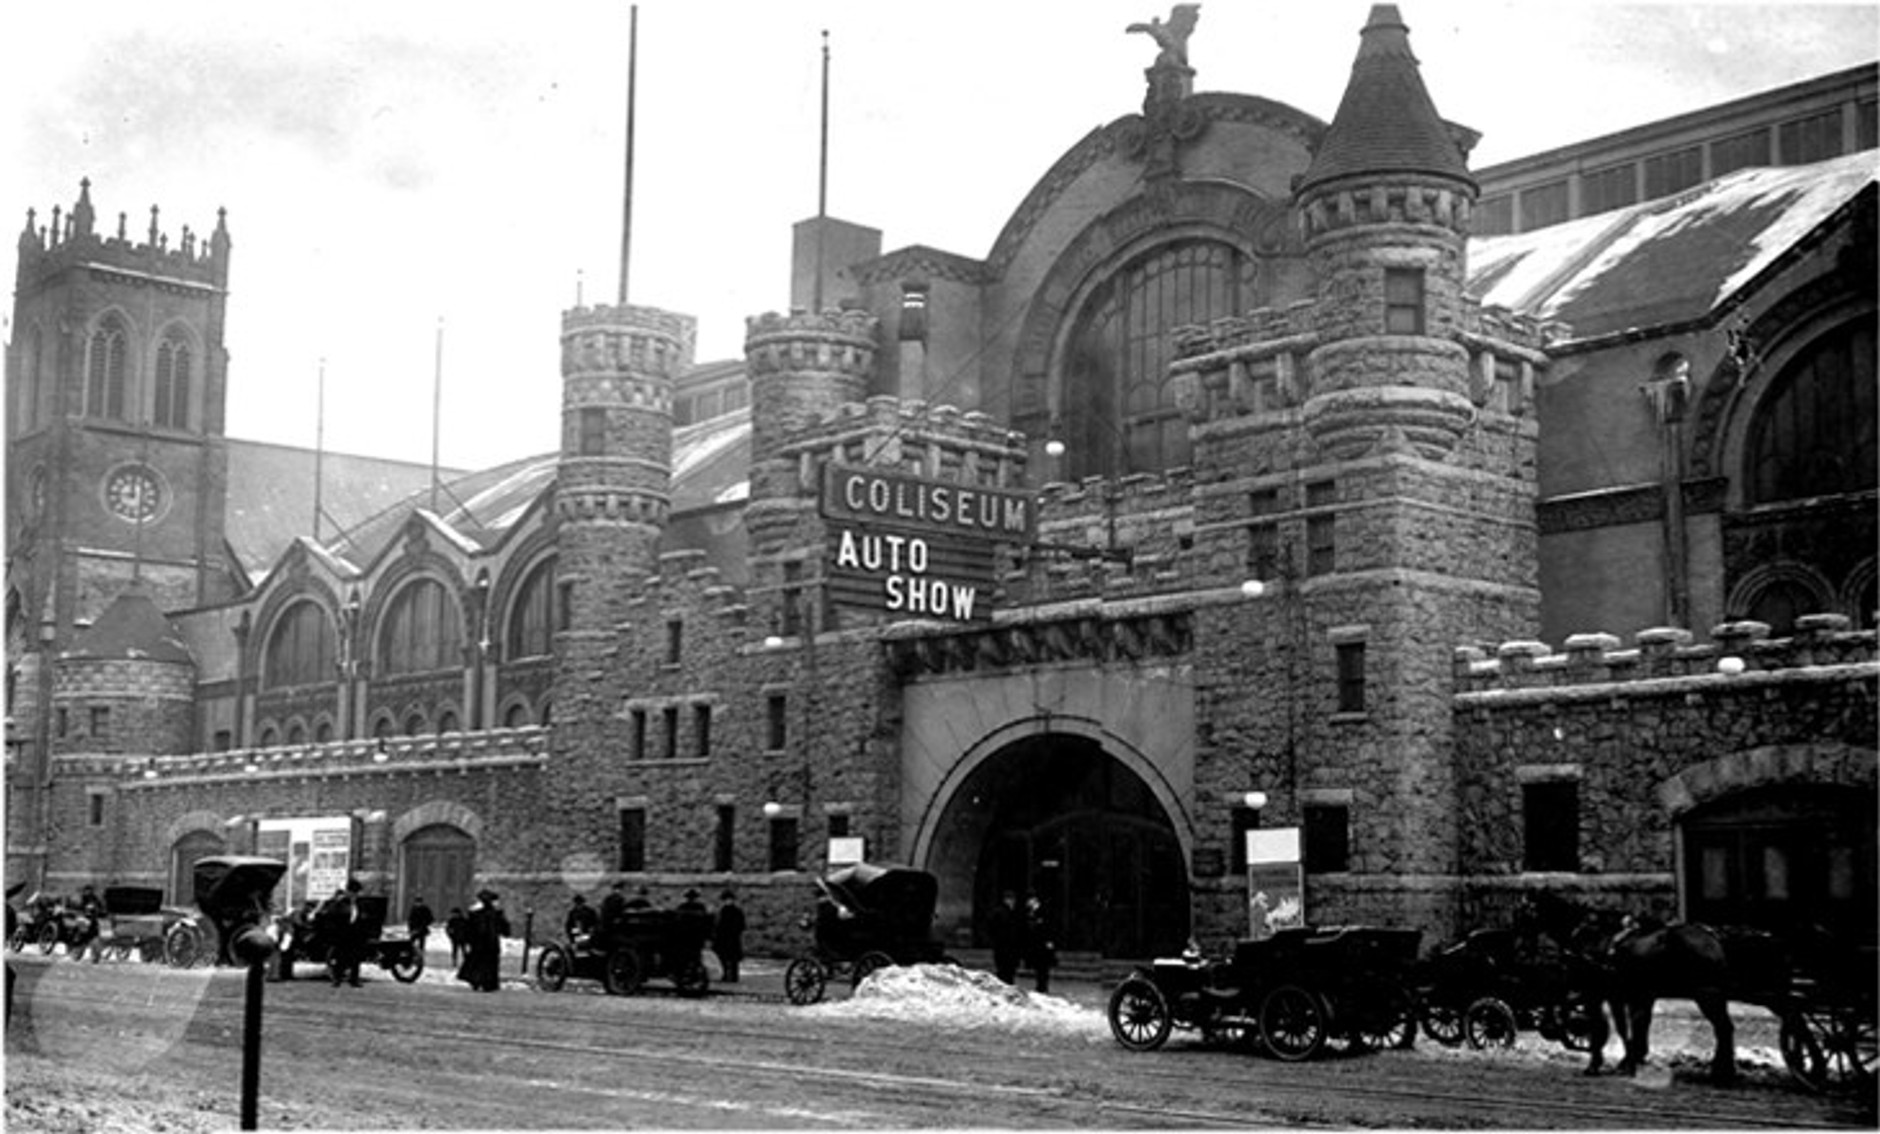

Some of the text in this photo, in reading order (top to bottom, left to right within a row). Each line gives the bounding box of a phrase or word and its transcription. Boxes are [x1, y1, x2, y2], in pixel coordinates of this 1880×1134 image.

[846, 475, 1026, 531] COLISEUM
[837, 529, 928, 573] AUTO
[886, 575, 975, 620] SHOW
